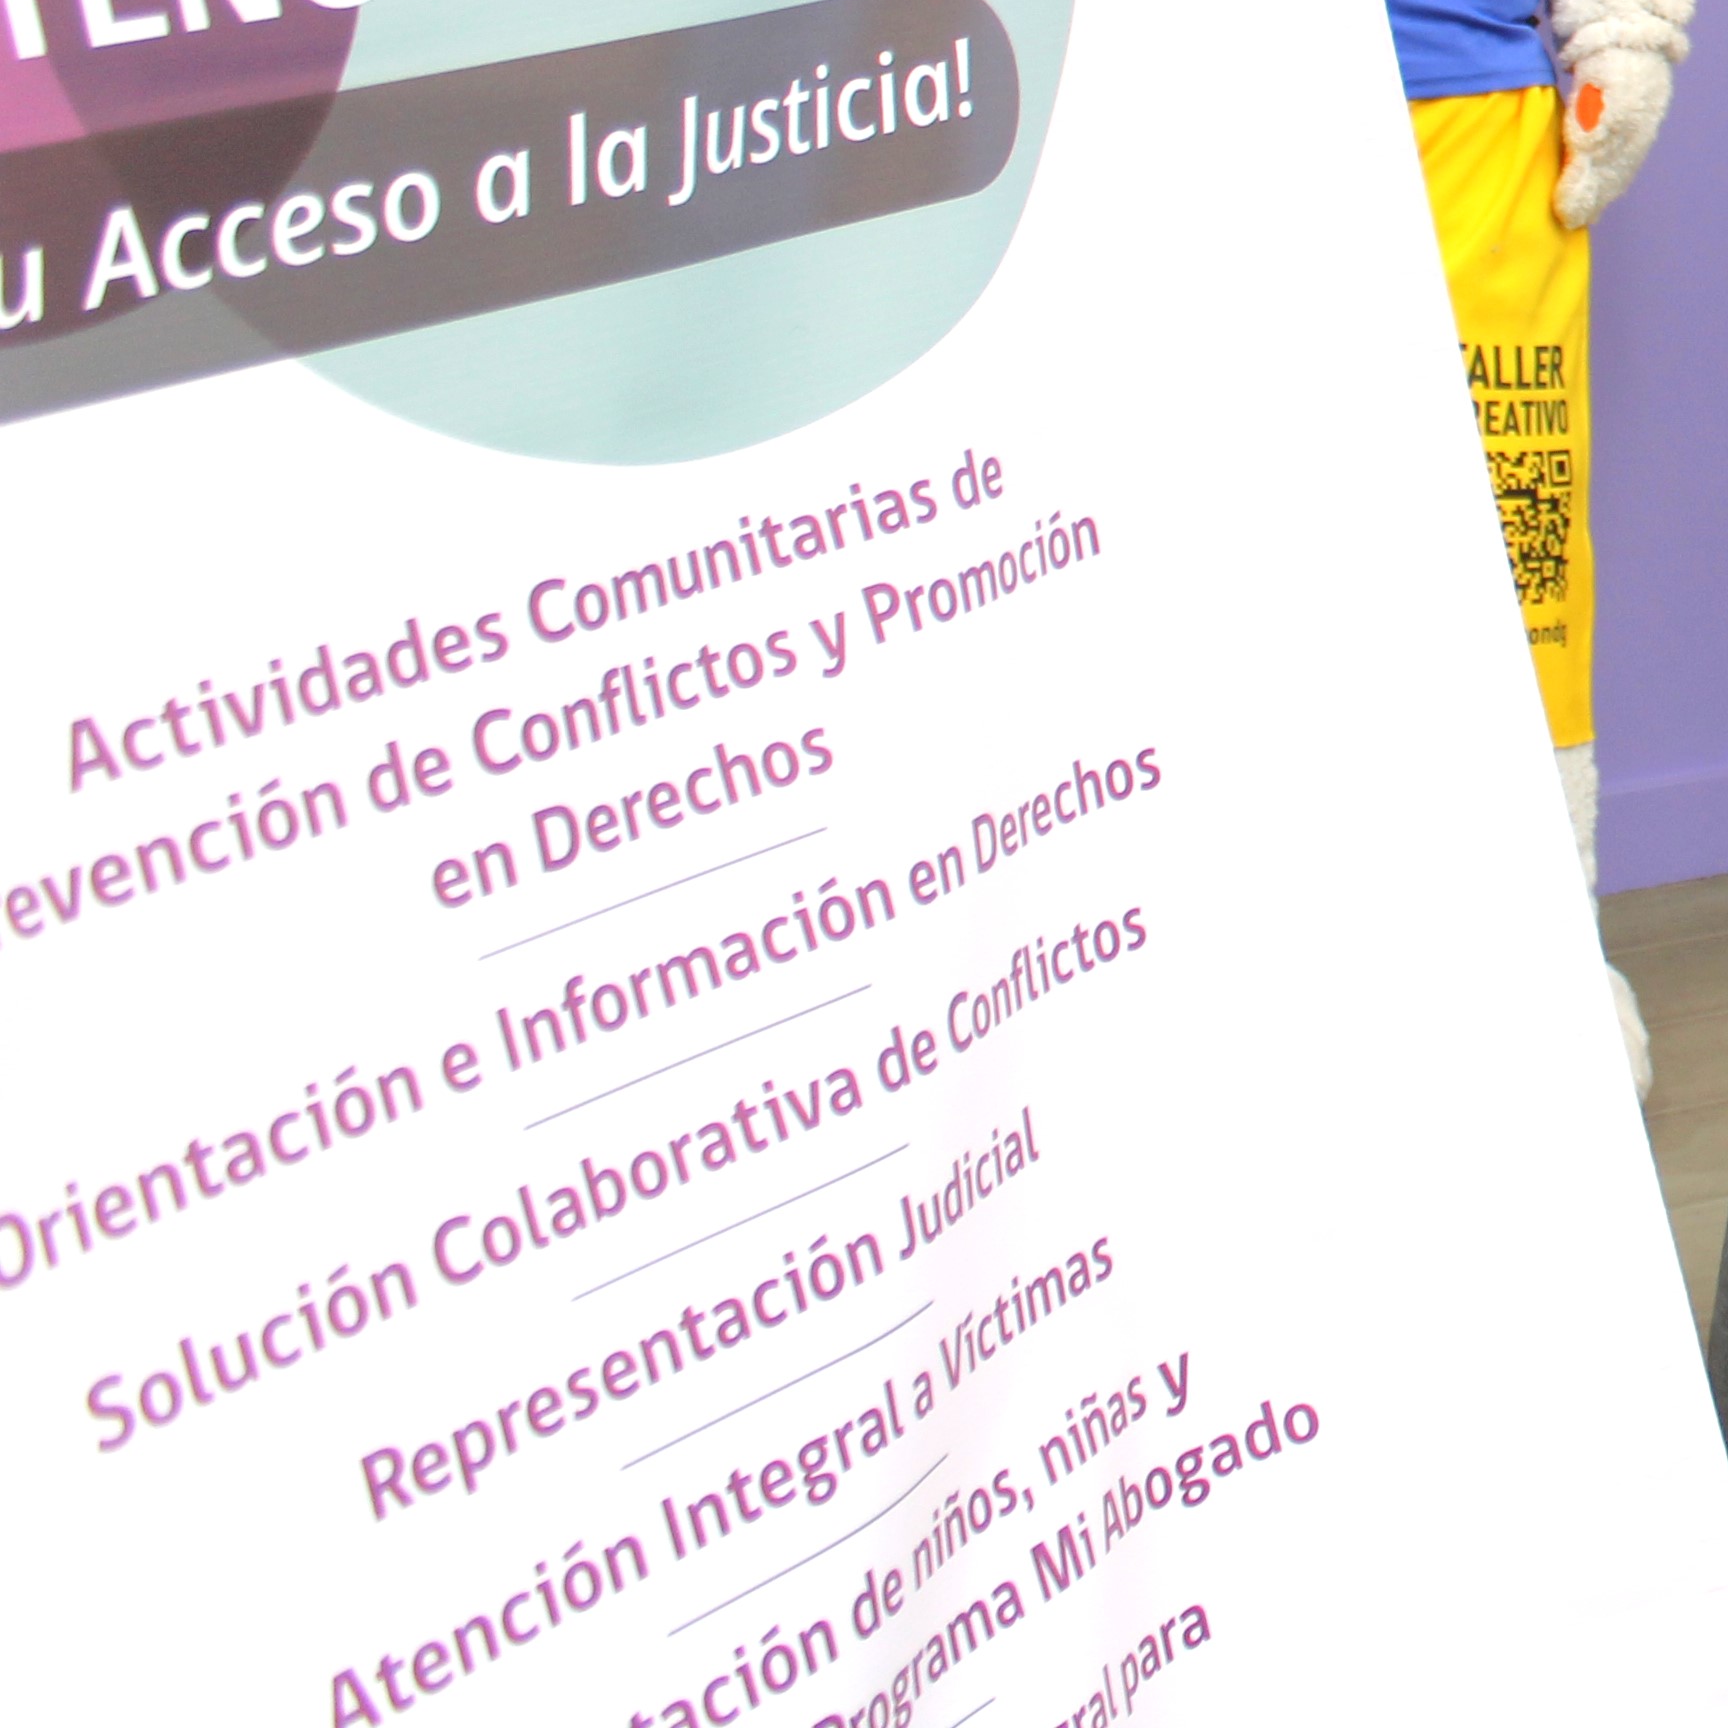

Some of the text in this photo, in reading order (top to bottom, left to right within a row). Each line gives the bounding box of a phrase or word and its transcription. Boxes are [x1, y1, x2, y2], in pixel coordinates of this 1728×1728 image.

[83, 171, 442, 312] Acceso
[476, 148, 532, 225] a
[570, 110, 649, 206] la
[669, 37, 976, 205] Justicia!
[67, 447, 1006, 792] Actividades Comunitarias de
[365, 739, 456, 812] de
[471, 617, 799, 778] Conflictos
[812, 608, 849, 681] y
[863, 510, 1103, 645] Promoción
[431, 721, 836, 909] en Derechos
[0, 741, 1164, 1287] Orientación e Información en Derechos
[85, 898, 1150, 1452] Solución Colaborativa de Conflictos
[359, 1104, 1041, 1520] Representación Judicial
[328, 1233, 1115, 1728] Atención Integral a Víctimas
[851, 1555, 906, 1646] de
[911, 1459, 1036, 1592] niños,
[1037, 1366, 1147, 1487] niñas
[1157, 1350, 1192, 1414] y
[1028, 1514, 1095, 1604] Mi
[1101, 1394, 1321, 1557] Abogado
[1122, 1601, 1213, 1715] para
